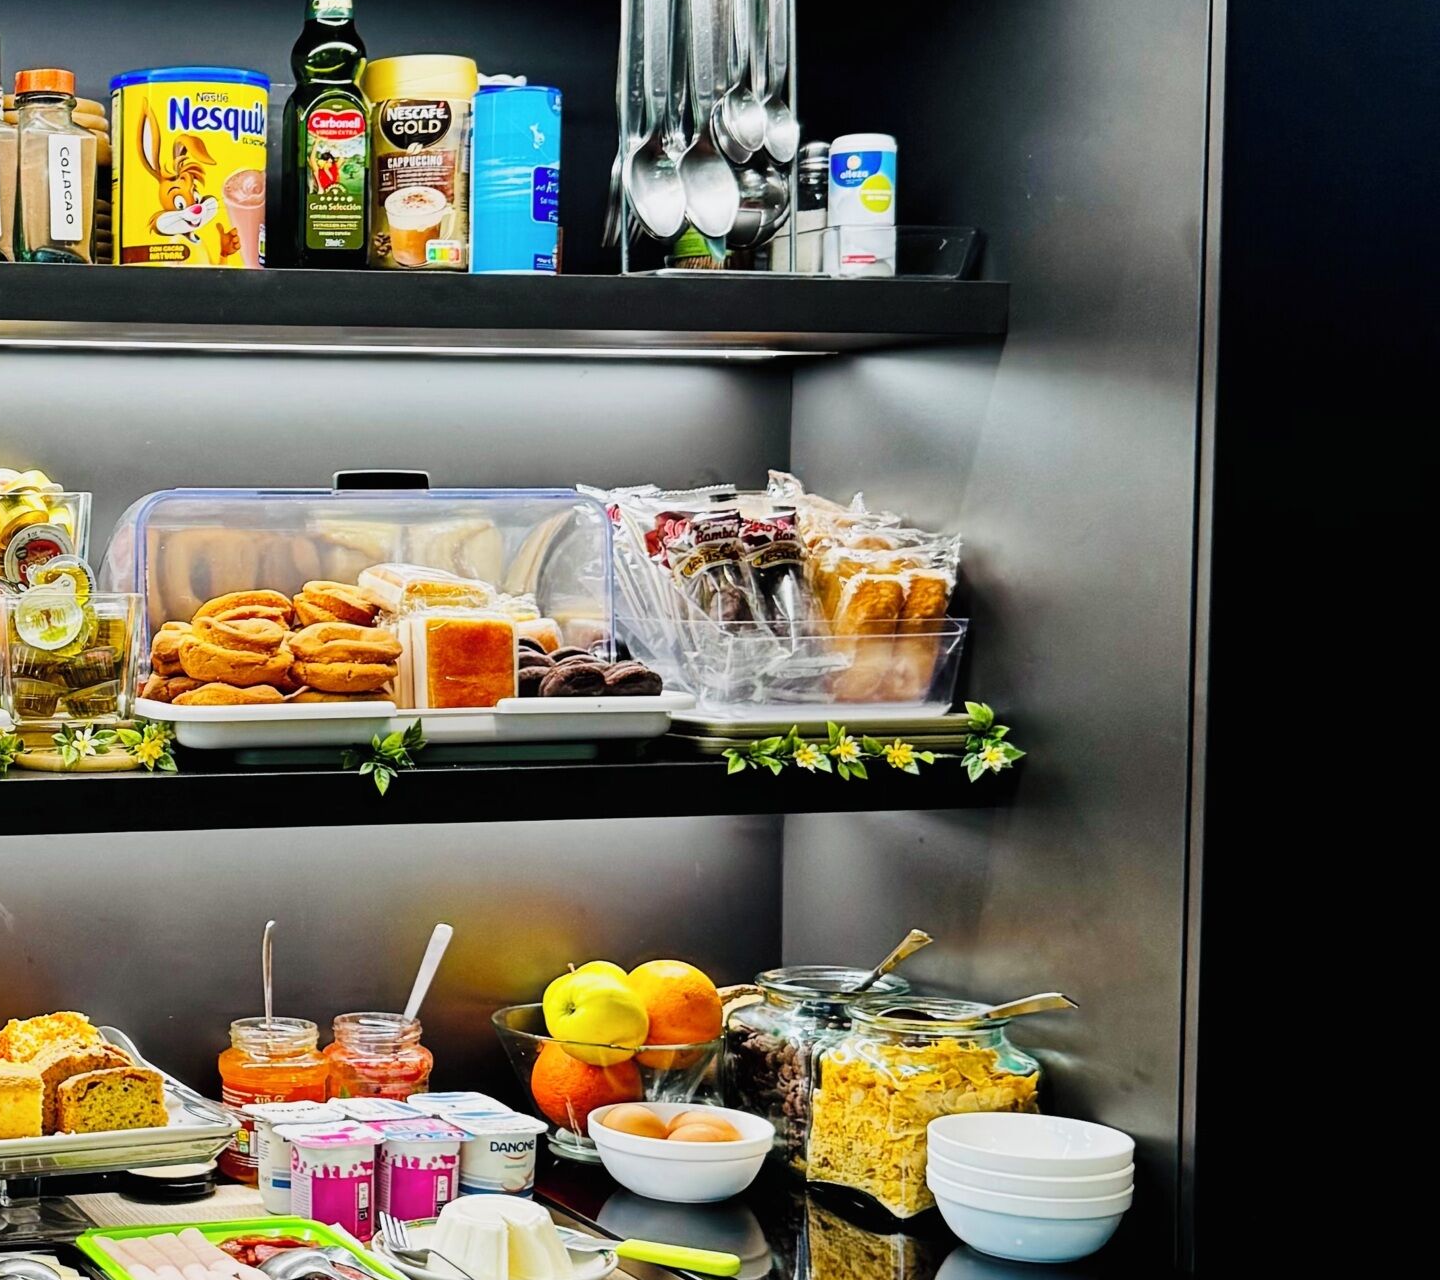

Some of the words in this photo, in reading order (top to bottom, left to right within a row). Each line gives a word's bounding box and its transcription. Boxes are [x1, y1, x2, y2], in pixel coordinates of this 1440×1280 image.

[312, 116, 361, 129] Carbonell
[392, 120, 442, 135] GOLD
[387, 154, 444, 169] CAPPUCCINO
[60, 146, 74, 225] COLACAO
[309, 202, 328, 210] Gran
[490, 1140, 535, 1153] DANONE
